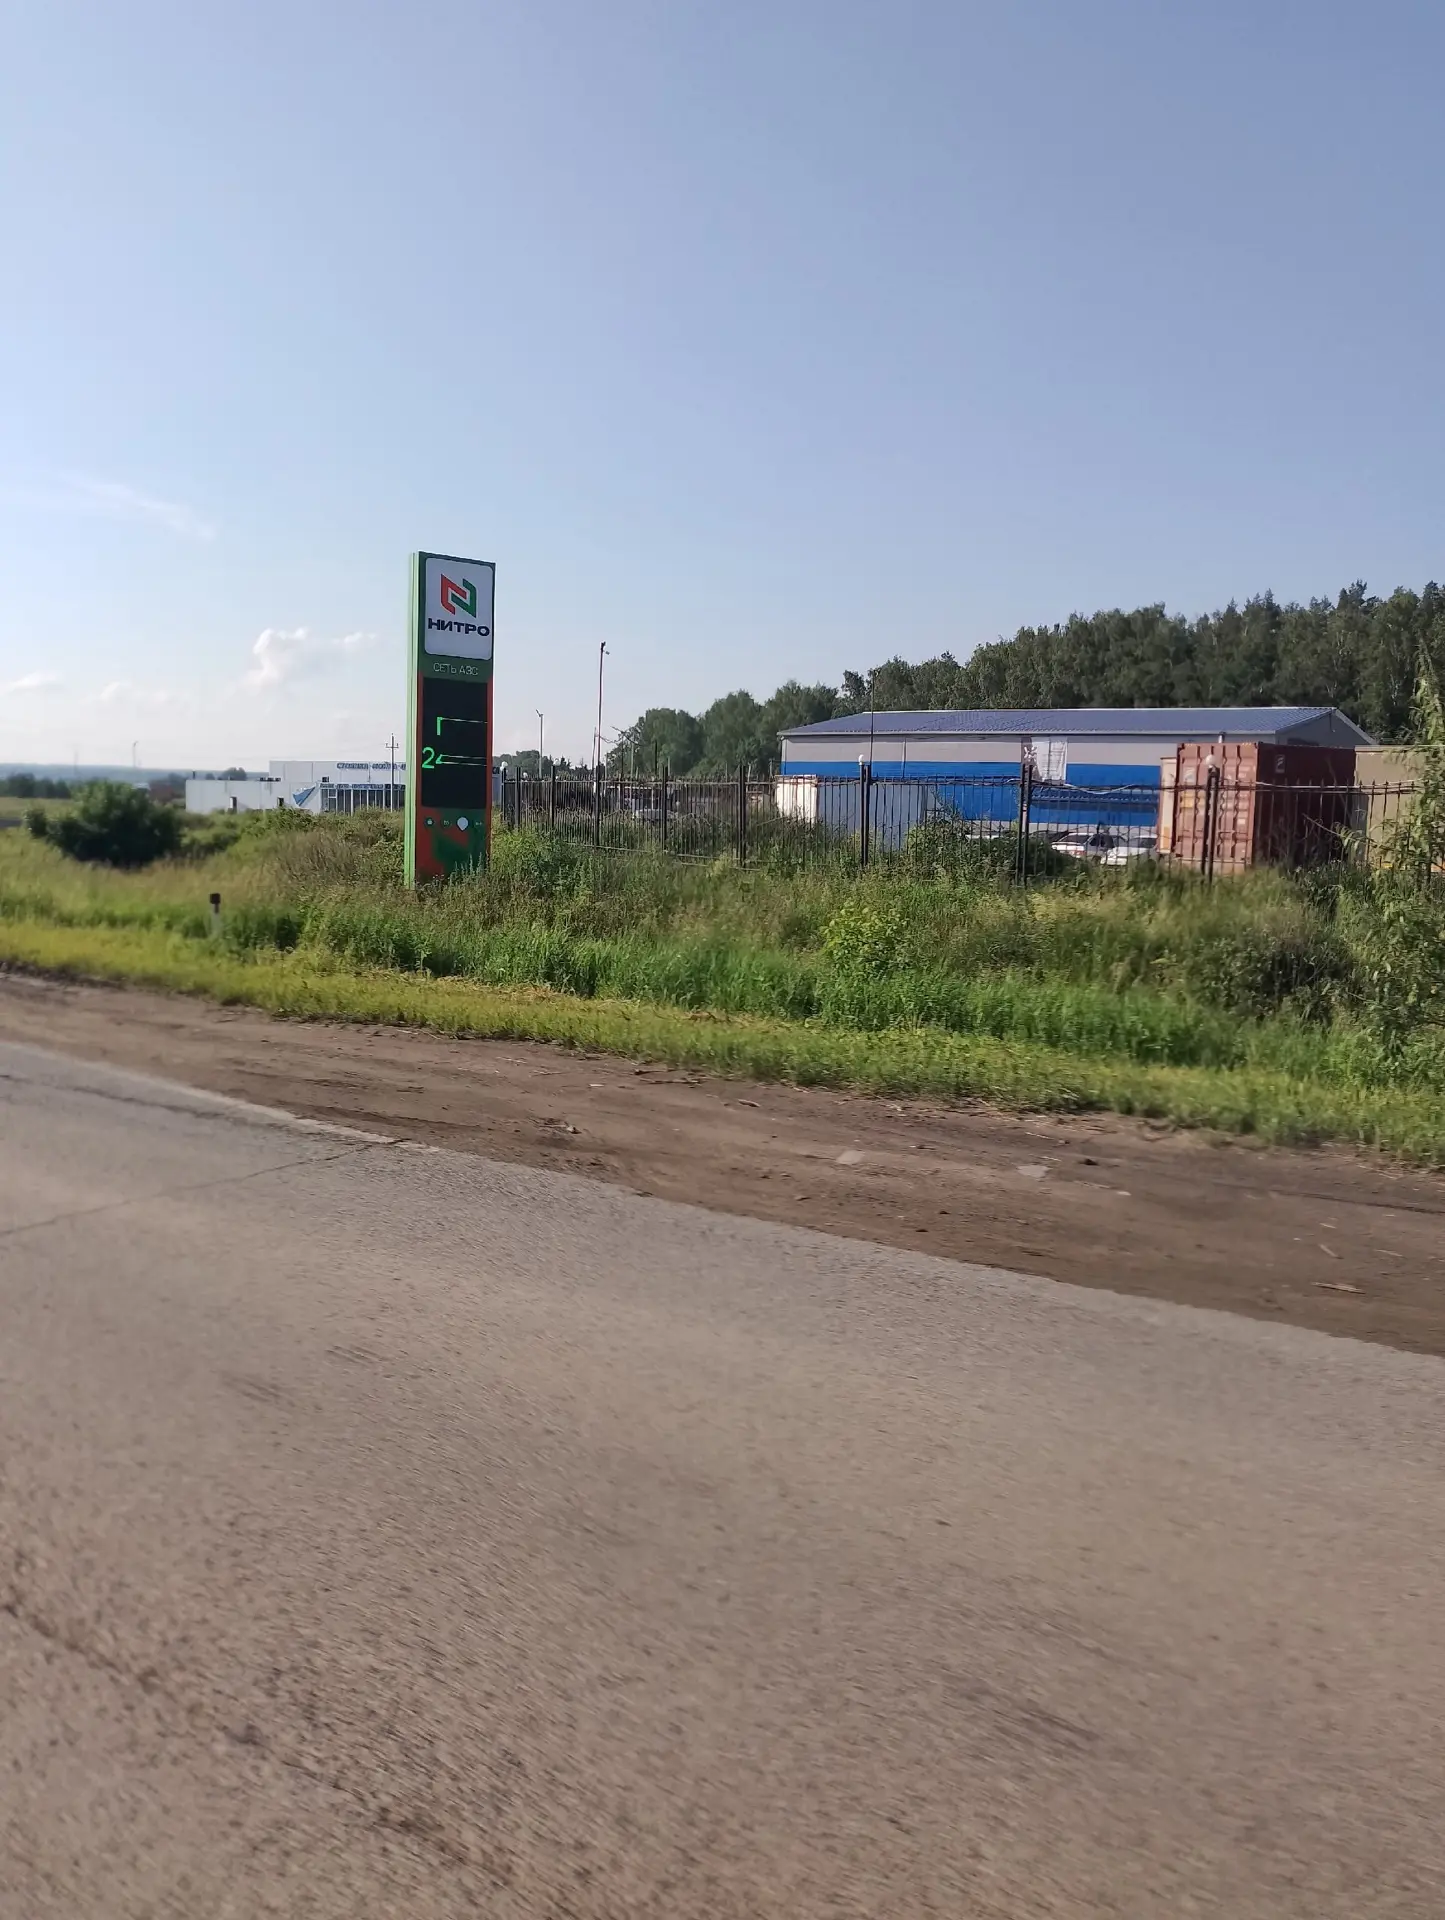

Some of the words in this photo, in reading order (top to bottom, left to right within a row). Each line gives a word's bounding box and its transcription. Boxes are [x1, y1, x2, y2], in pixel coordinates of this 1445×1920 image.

[428, 618, 490, 636] НИТРО
[433, 662, 457, 674] СЕТЬ
[459, 665, 478, 676] АЗС
